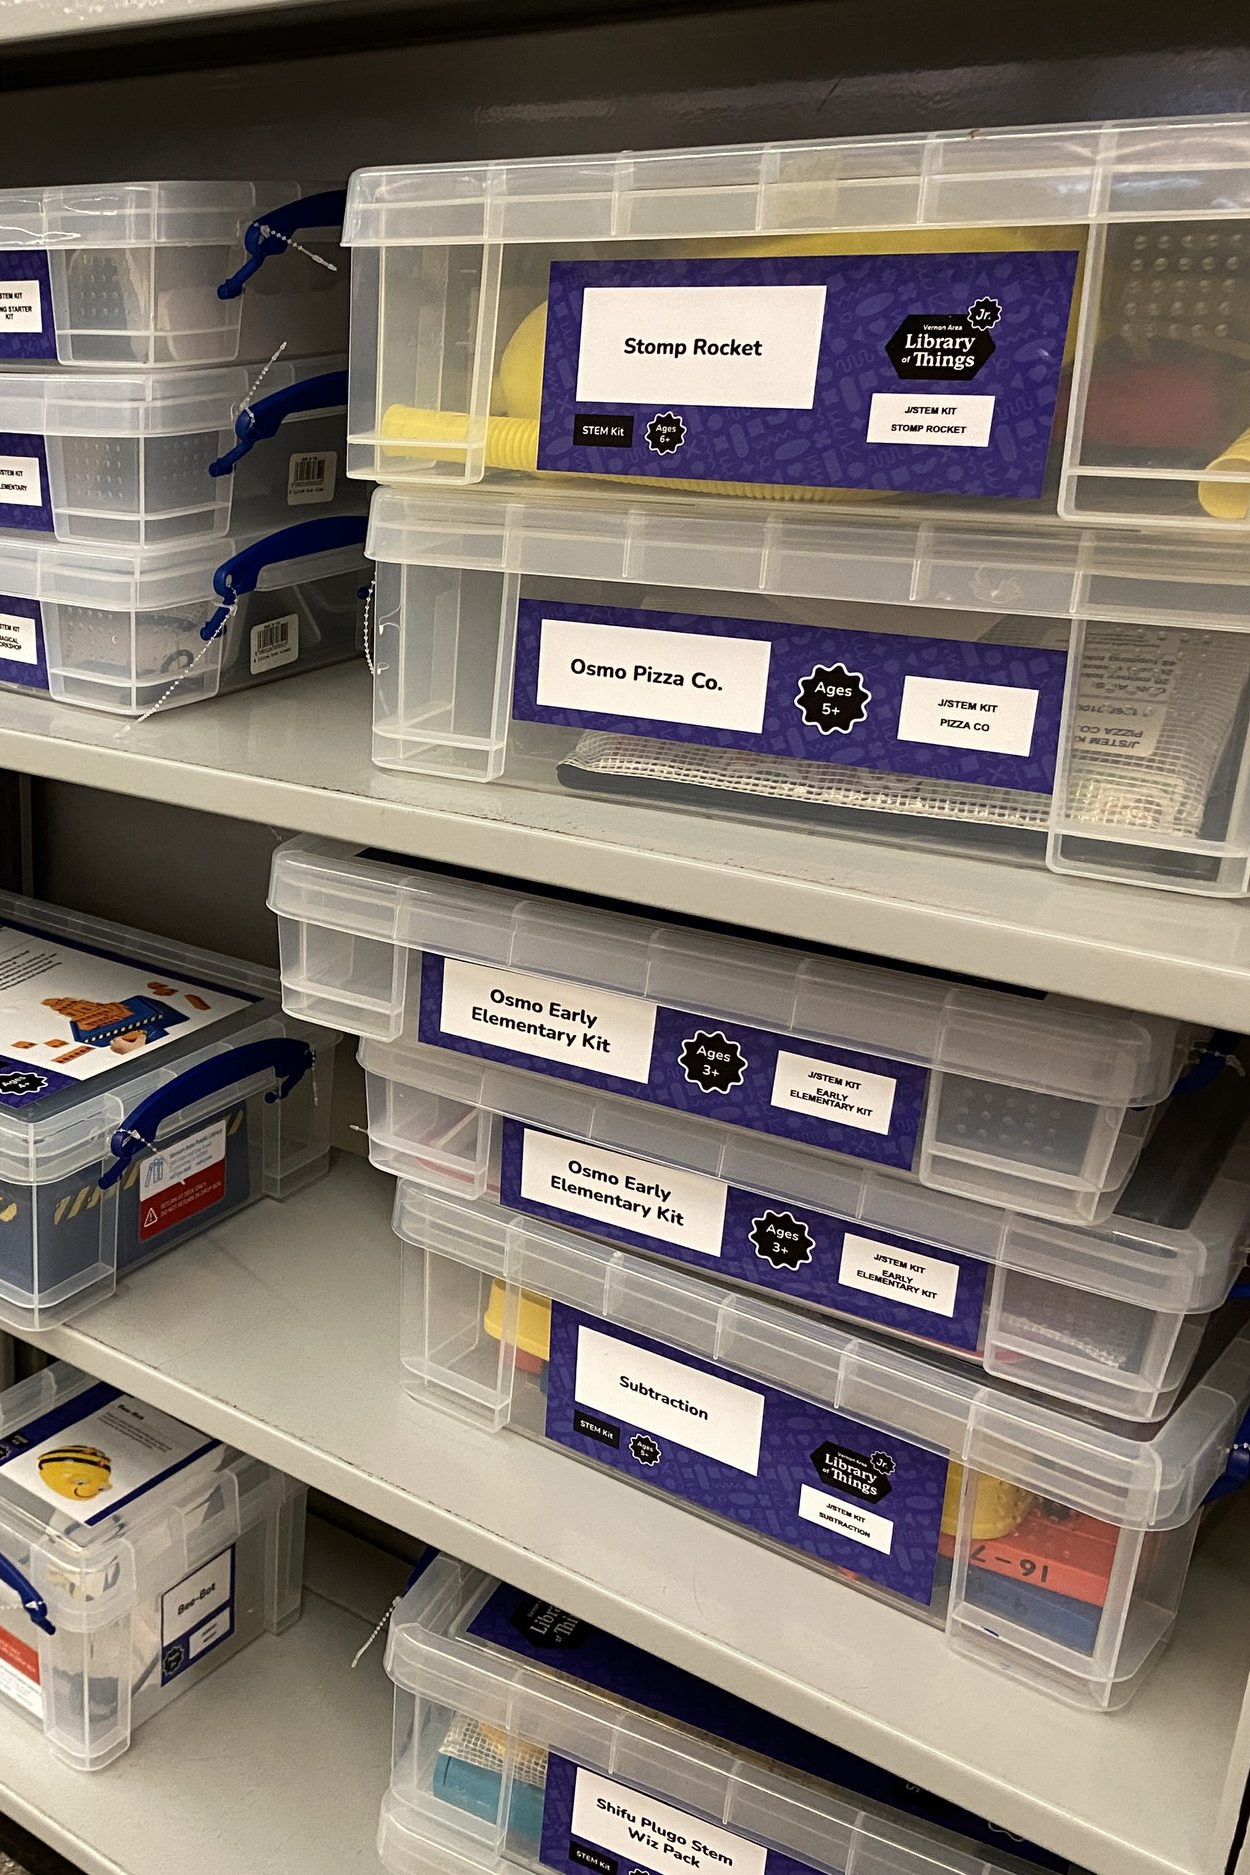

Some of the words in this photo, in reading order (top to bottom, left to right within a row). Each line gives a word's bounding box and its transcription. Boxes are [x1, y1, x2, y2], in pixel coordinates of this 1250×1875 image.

[976, 308, 992, 320] Jr.
[624, 337, 687, 359] Stomp
[694, 338, 763, 356] Rocket
[905, 333, 976, 353] Library
[913, 352, 975, 371] Things
[904, 406, 939, 414] J/STEM
[941, 407, 957, 415] KIT
[582, 425, 609, 436] STEM
[610, 426, 624, 436] Kit
[656, 424, 676, 434] Ages
[891, 424, 923, 432] STOMP
[926, 426, 967, 434] ROCKET
[660, 434, 670, 443] 6+
[12, 625, 20, 633] KIT
[570, 658, 627, 681] Osmo
[634, 665, 684, 686] Pizza
[691, 672, 723, 692] Co.
[814, 680, 853, 698] Ages
[822, 702, 841, 716] 5+
[938, 699, 978, 712] J/STEM
[980, 703, 998, 713] KIT
[940, 718, 970, 730] PIZZA
[973, 722, 990, 732] CO
[1105, 728, 1144, 738] PIZZA
[1089, 737, 1140, 749] J/STEM
[490, 988, 544, 1014] Osmo
[549, 1002, 598, 1029] Early
[472, 1006, 577, 1047] Elementary
[582, 1032, 611, 1053] Kit
[696, 1045, 731, 1063] Ages
[702, 1064, 720, 1077] 3+
[2, 1076, 26, 1087] Ages
[808, 1071, 843, 1086] J/STEM
[844, 1080, 862, 1090] KIT
[790, 1090, 855, 1112] ELEMENTARY
[856, 1106, 873, 1117] KIT
[816, 1088, 849, 1102] EARLY
[568, 1160, 619, 1186] Osmo
[625, 1176, 671, 1202] Early
[551, 1175, 651, 1218] Elementary
[657, 1206, 685, 1226] Kit
[766, 1224, 799, 1241] Ages
[772, 1242, 788, 1254] 3+
[874, 1254, 908, 1269] J/STEM
[910, 1264, 926, 1274] KIT
[856, 1270, 920, 1295] ELEMENTARY
[922, 1289, 937, 1300] KIT
[882, 1269, 914, 1284] EARLY
[620, 1376, 709, 1421] Subtraction
[580, 1420, 601, 1434] STEM
[602, 1428, 614, 1440] Kit
[637, 1441, 654, 1453] Ages
[825, 1453, 878, 1484] Library
[856, 1460, 868, 1468] Area
[876, 1458, 889, 1469] Jr.
[832, 1468, 878, 1495] Things
[826, 1503, 852, 1518] J/STEM
[854, 1514, 866, 1524] KIT
[819, 1512, 871, 1538] SUBTRACTION
[178, 1583, 216, 1615] Bee-Bot
[596, 1798, 636, 1824] Shifu
[640, 1815, 687, 1847] Plugo
[691, 1838, 734, 1867] Stem
[628, 1826, 659, 1851] Wiz
[663, 1842, 701, 1869] Pack
[576, 1850, 598, 1866] STEM
[600, 1861, 611, 1872] Kit
